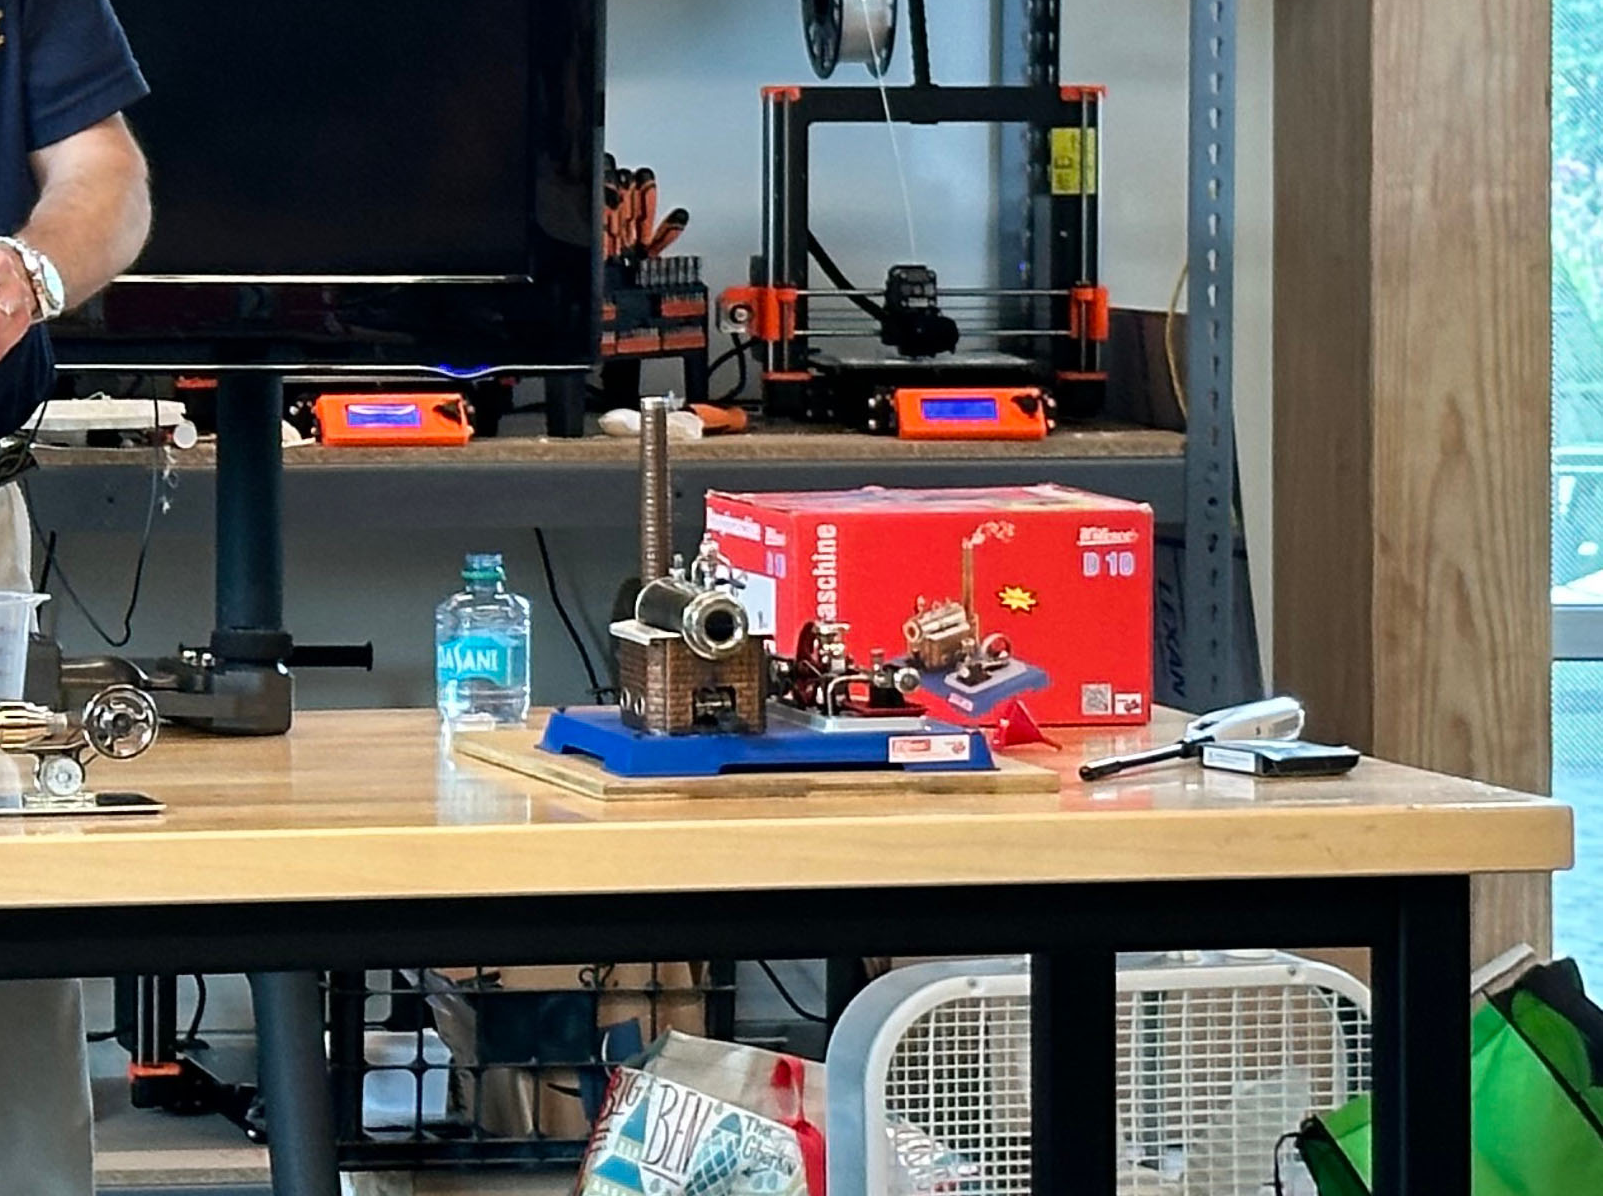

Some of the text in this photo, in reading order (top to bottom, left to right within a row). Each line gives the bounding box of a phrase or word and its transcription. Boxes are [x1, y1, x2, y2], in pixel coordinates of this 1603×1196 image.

[811, 523, 838, 621] aschine
[1083, 550, 1136, 577] D 10
[643, 1083, 714, 1175] BEN
